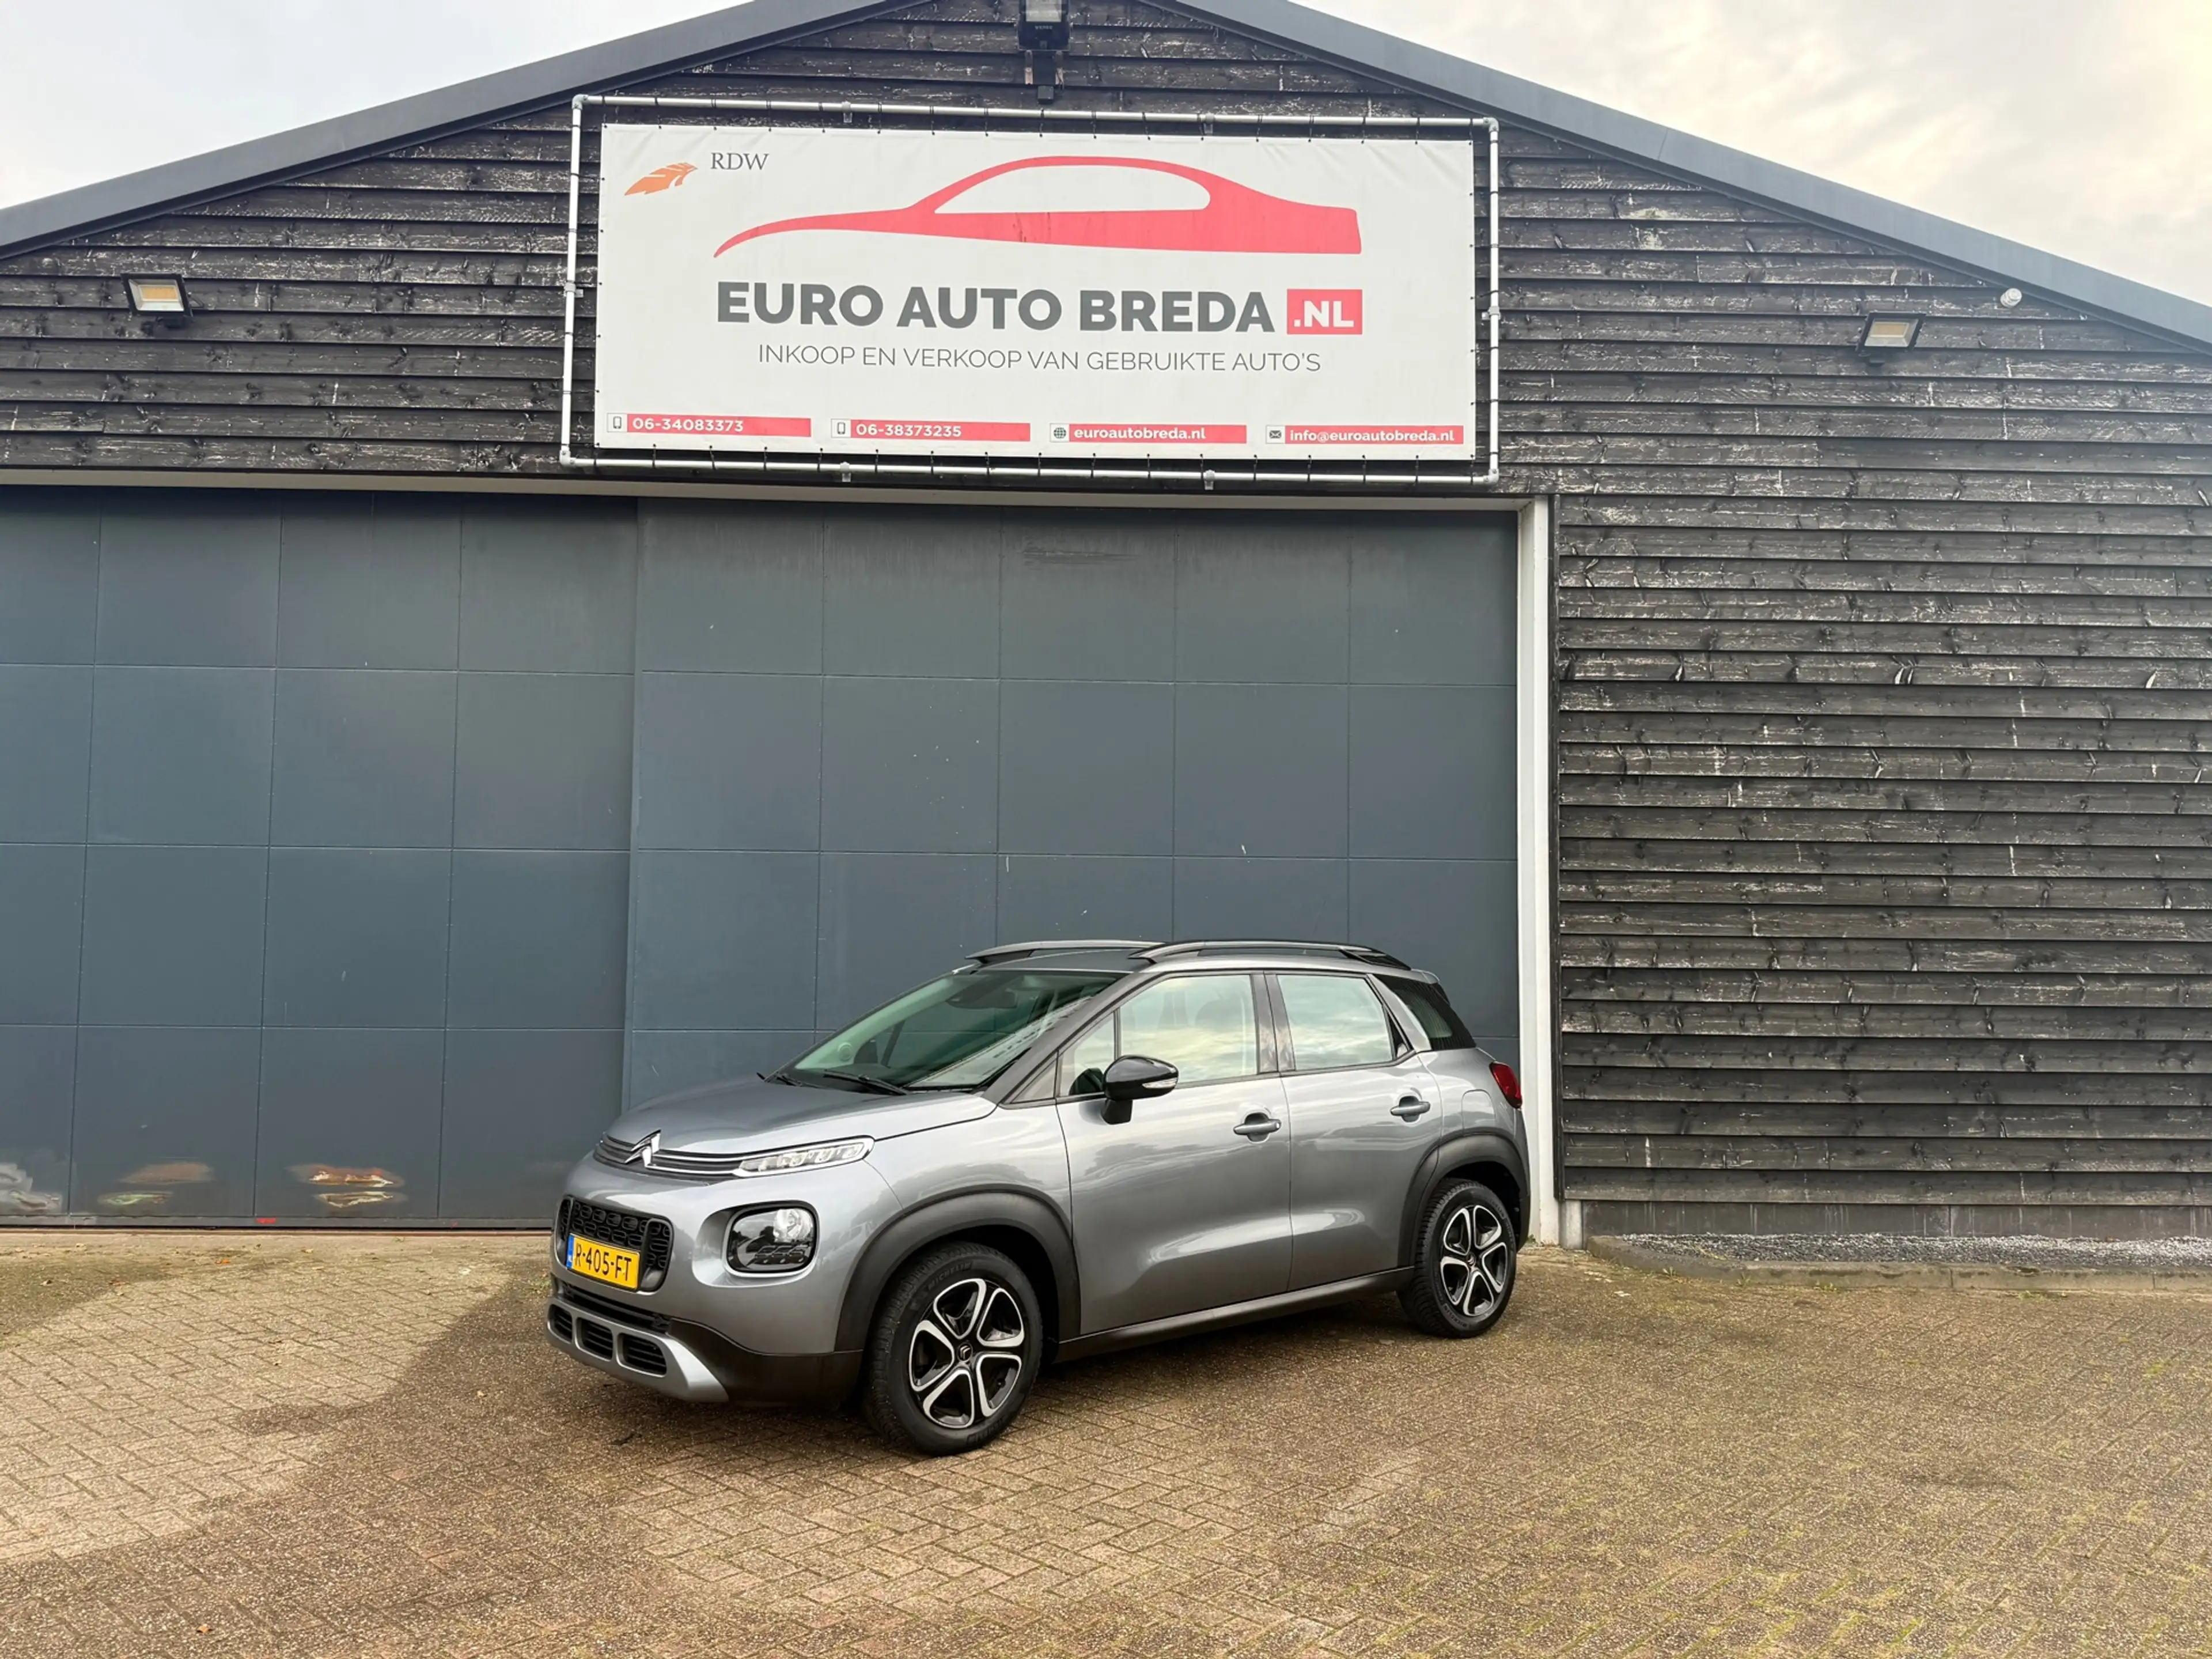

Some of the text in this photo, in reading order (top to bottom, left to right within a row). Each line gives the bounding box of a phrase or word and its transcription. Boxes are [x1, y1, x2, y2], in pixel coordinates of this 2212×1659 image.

[710, 152, 770, 171] RDW
[717, 281, 1354, 333] EURO AUTO BREDA .NL
[759, 344, 1321, 372] INKOOP EN VERKOOP VAN GEBRUIKTE AUTO'S
[632, 417, 744, 432] 06-34083373
[856, 423, 962, 437] 06-38373235
[1074, 427, 1206, 440] euroautobreda.nl
[1290, 430, 1455, 442] info@euroautobreda.nl
